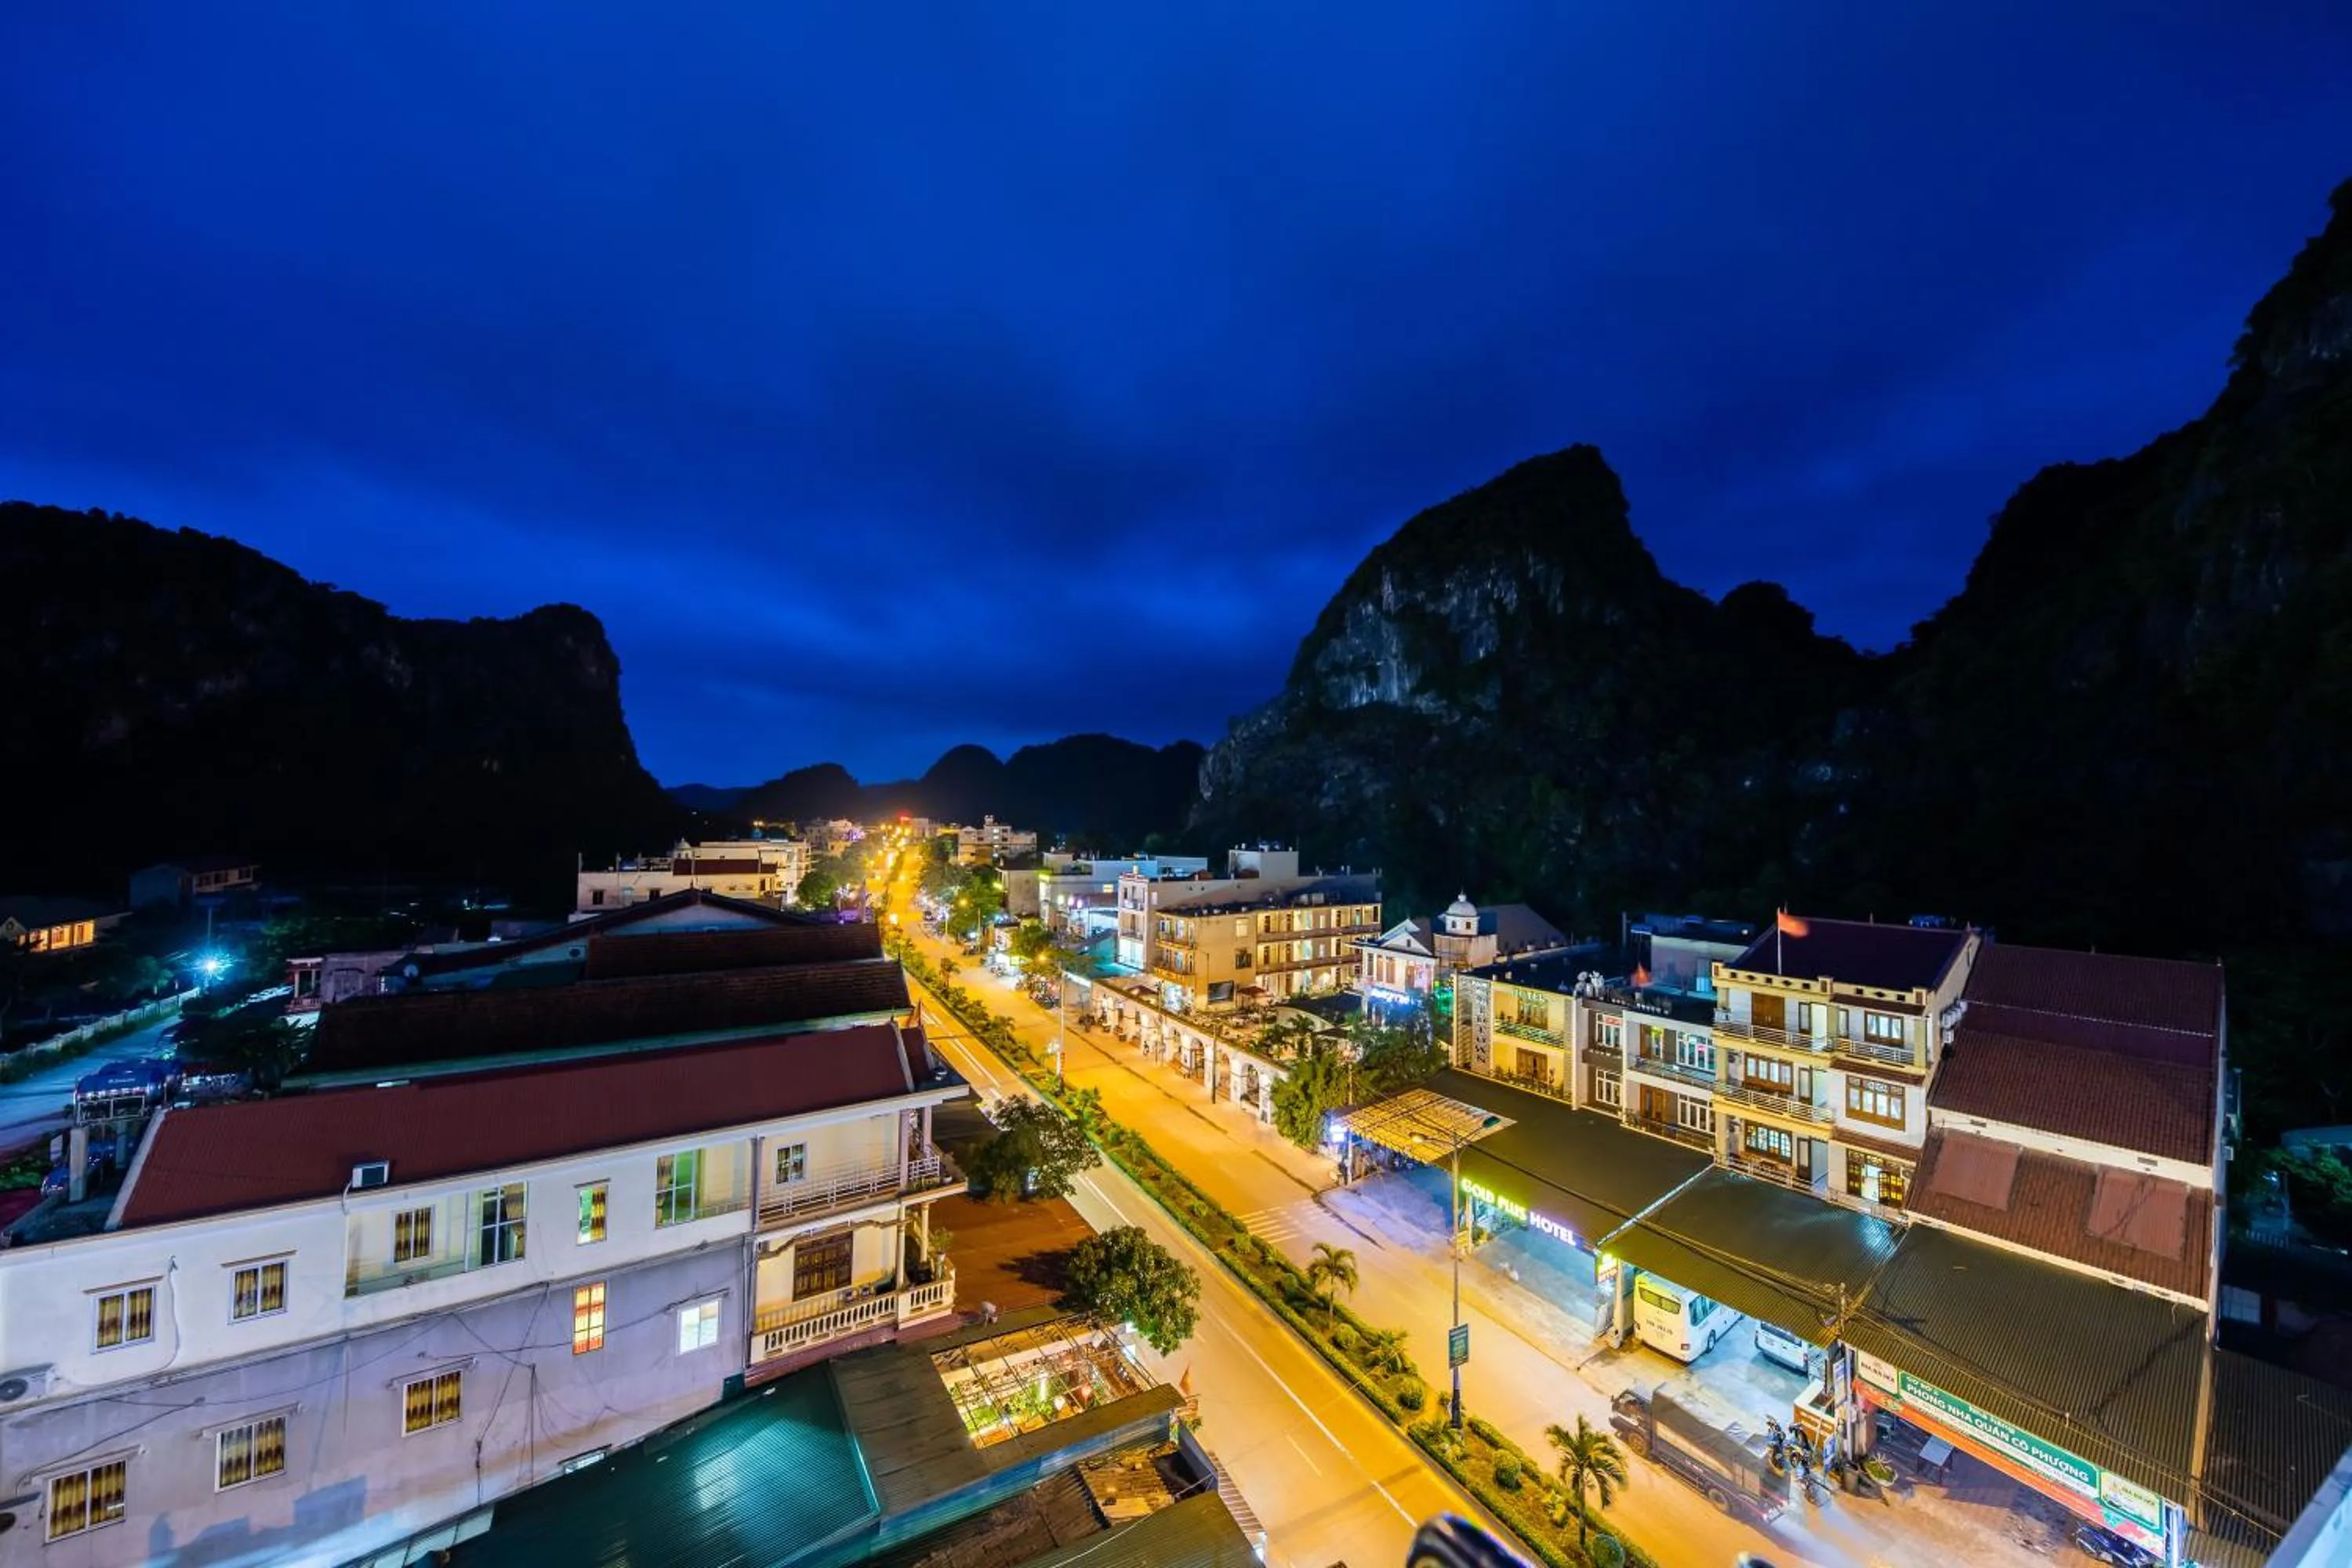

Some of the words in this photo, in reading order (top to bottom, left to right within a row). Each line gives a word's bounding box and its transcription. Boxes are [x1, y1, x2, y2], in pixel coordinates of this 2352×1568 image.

[1461, 1178, 1494, 1203] GOLD
[1497, 1196, 1526, 1221] PLUS
[1530, 1211, 1577, 1246] HOTEL
[1906, 1383, 1945, 1408] PHONG
